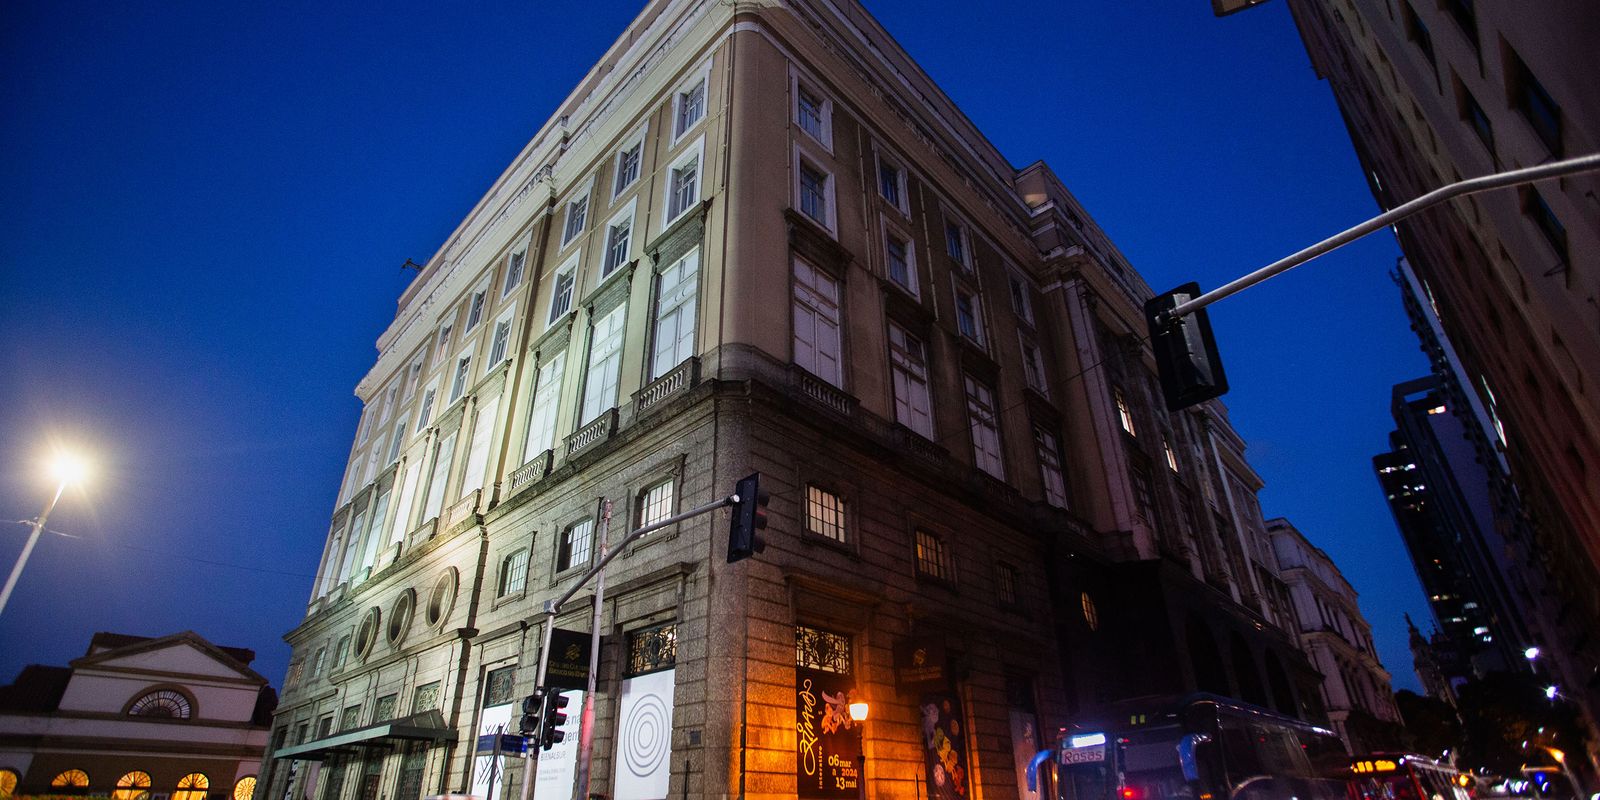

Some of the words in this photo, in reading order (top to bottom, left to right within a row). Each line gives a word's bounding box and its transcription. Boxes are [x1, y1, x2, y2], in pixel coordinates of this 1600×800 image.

[828, 754, 839, 766] 06
[840, 760, 851, 768] mar
[841, 768, 858, 778] 2024
[835, 777, 845, 790] 13
